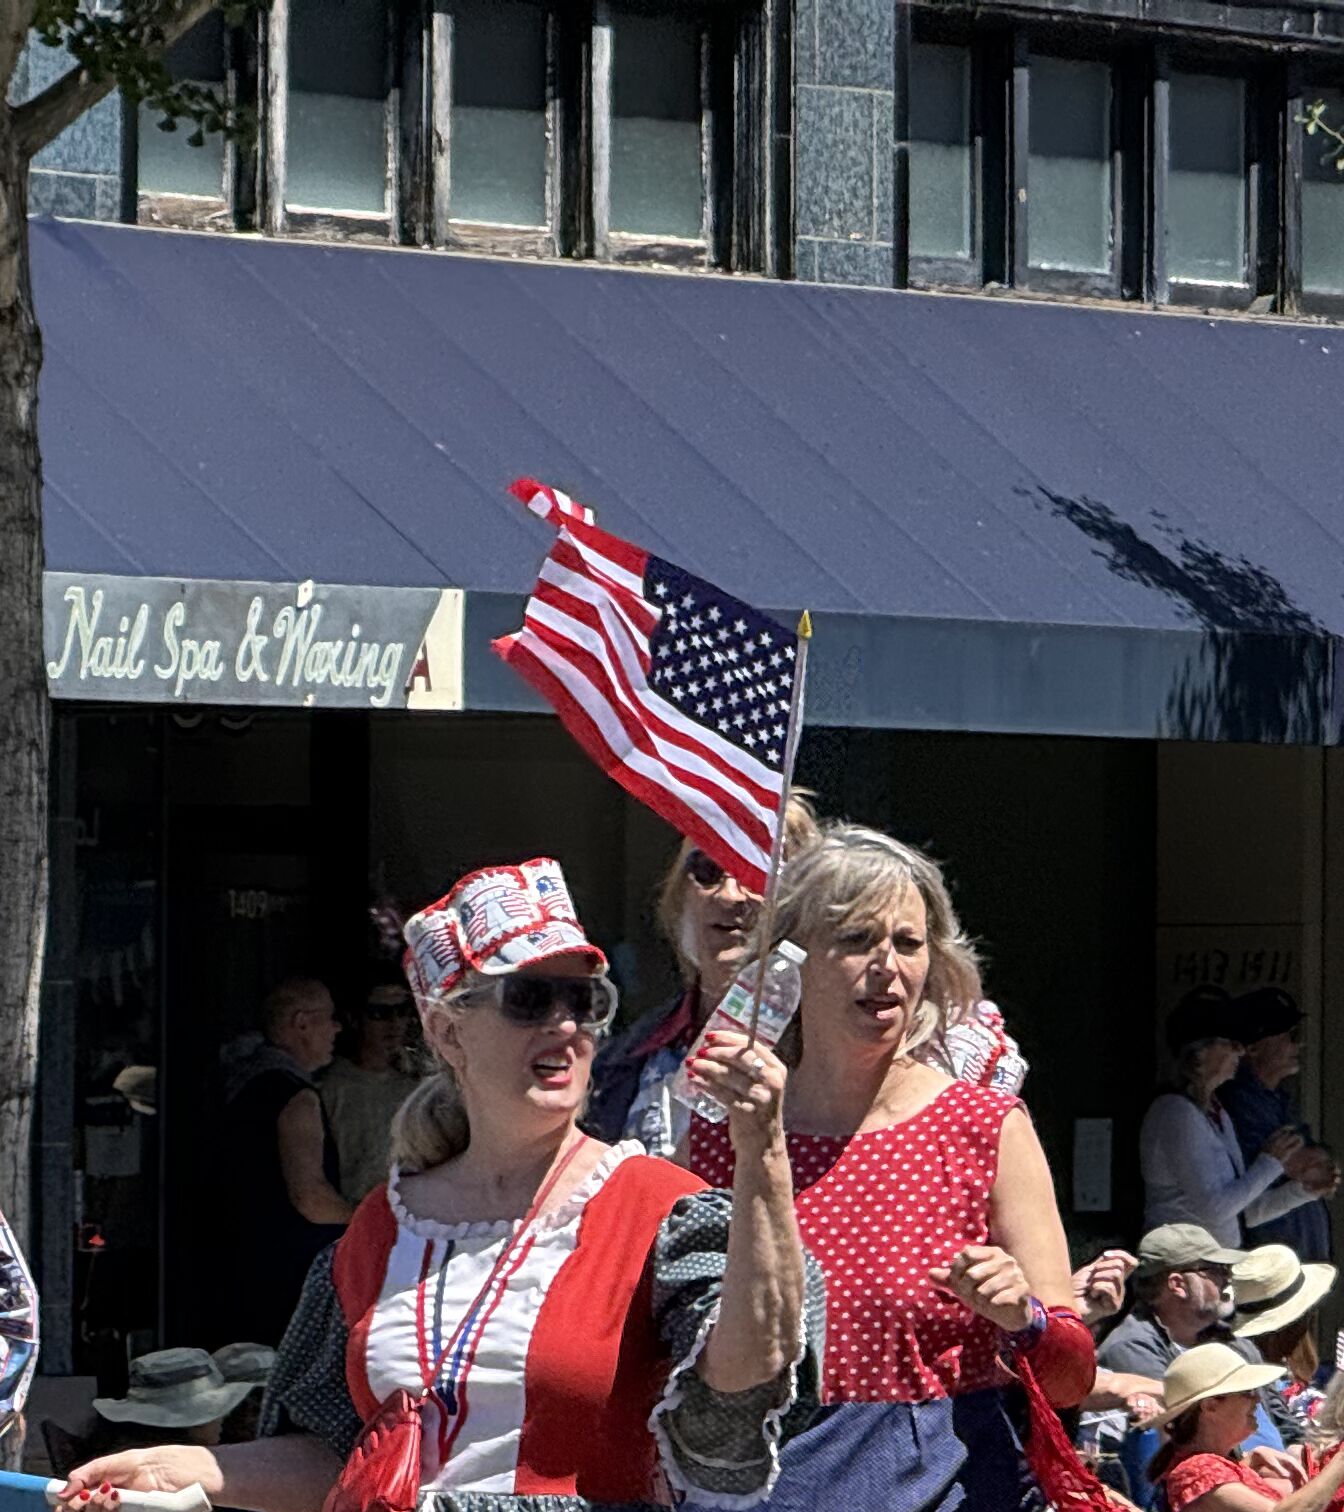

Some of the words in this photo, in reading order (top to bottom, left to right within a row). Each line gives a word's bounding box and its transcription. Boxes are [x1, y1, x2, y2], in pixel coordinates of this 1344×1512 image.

[47, 586, 148, 680] Nail
[154, 601, 224, 697] Spa
[235, 597, 268, 682] &
[273, 603, 404, 708] Waxing
